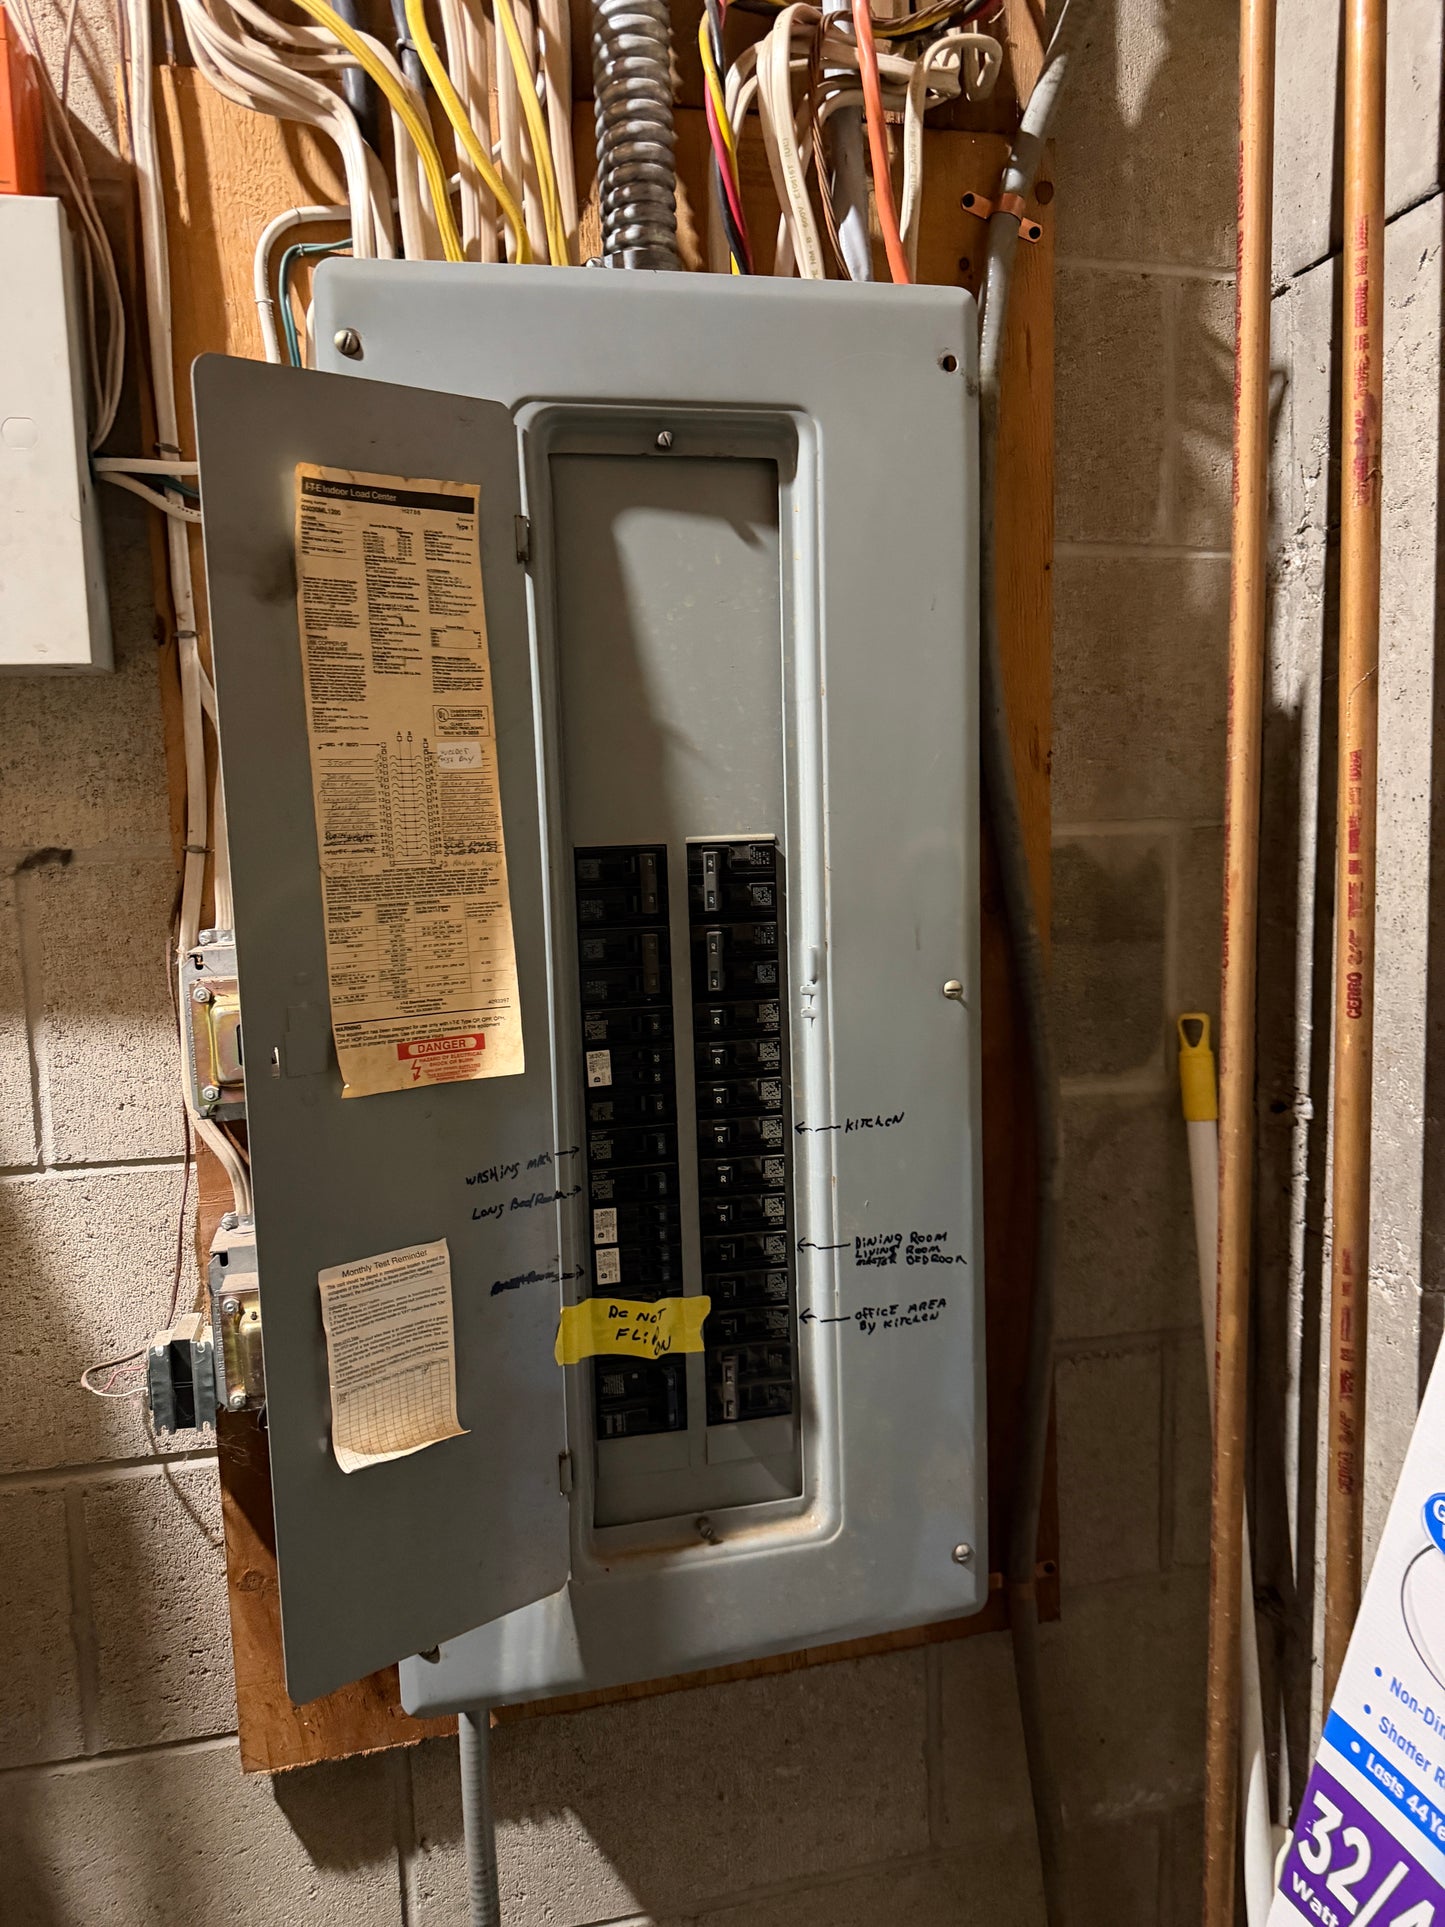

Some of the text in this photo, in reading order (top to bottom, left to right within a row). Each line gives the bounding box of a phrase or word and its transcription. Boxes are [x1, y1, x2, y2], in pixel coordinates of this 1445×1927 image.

[322, 484, 349, 495] Indoor
[350, 489, 371, 498] Load
[372, 491, 397, 501] Center
[456, 522, 470, 531] Type
[1346, 973, 1362, 1019] CERRO
[417, 1039, 466, 1053] DANGER
[910, 1231, 948, 1244] ROOM
[906, 1245, 941, 1254] ROOM
[341, 1250, 428, 1278] Monthly Test Reminder
[608, 1305, 667, 1323] DO NOT
[908, 1298, 947, 1313] AREA
[654, 1336, 671, 1355] ON
[1378, 1716, 1432, 1774] Shatter
[1365, 1752, 1405, 1800] Lasts
[1406, 1794, 1428, 1823] 44
[1292, 1870, 1339, 1927] Watt
